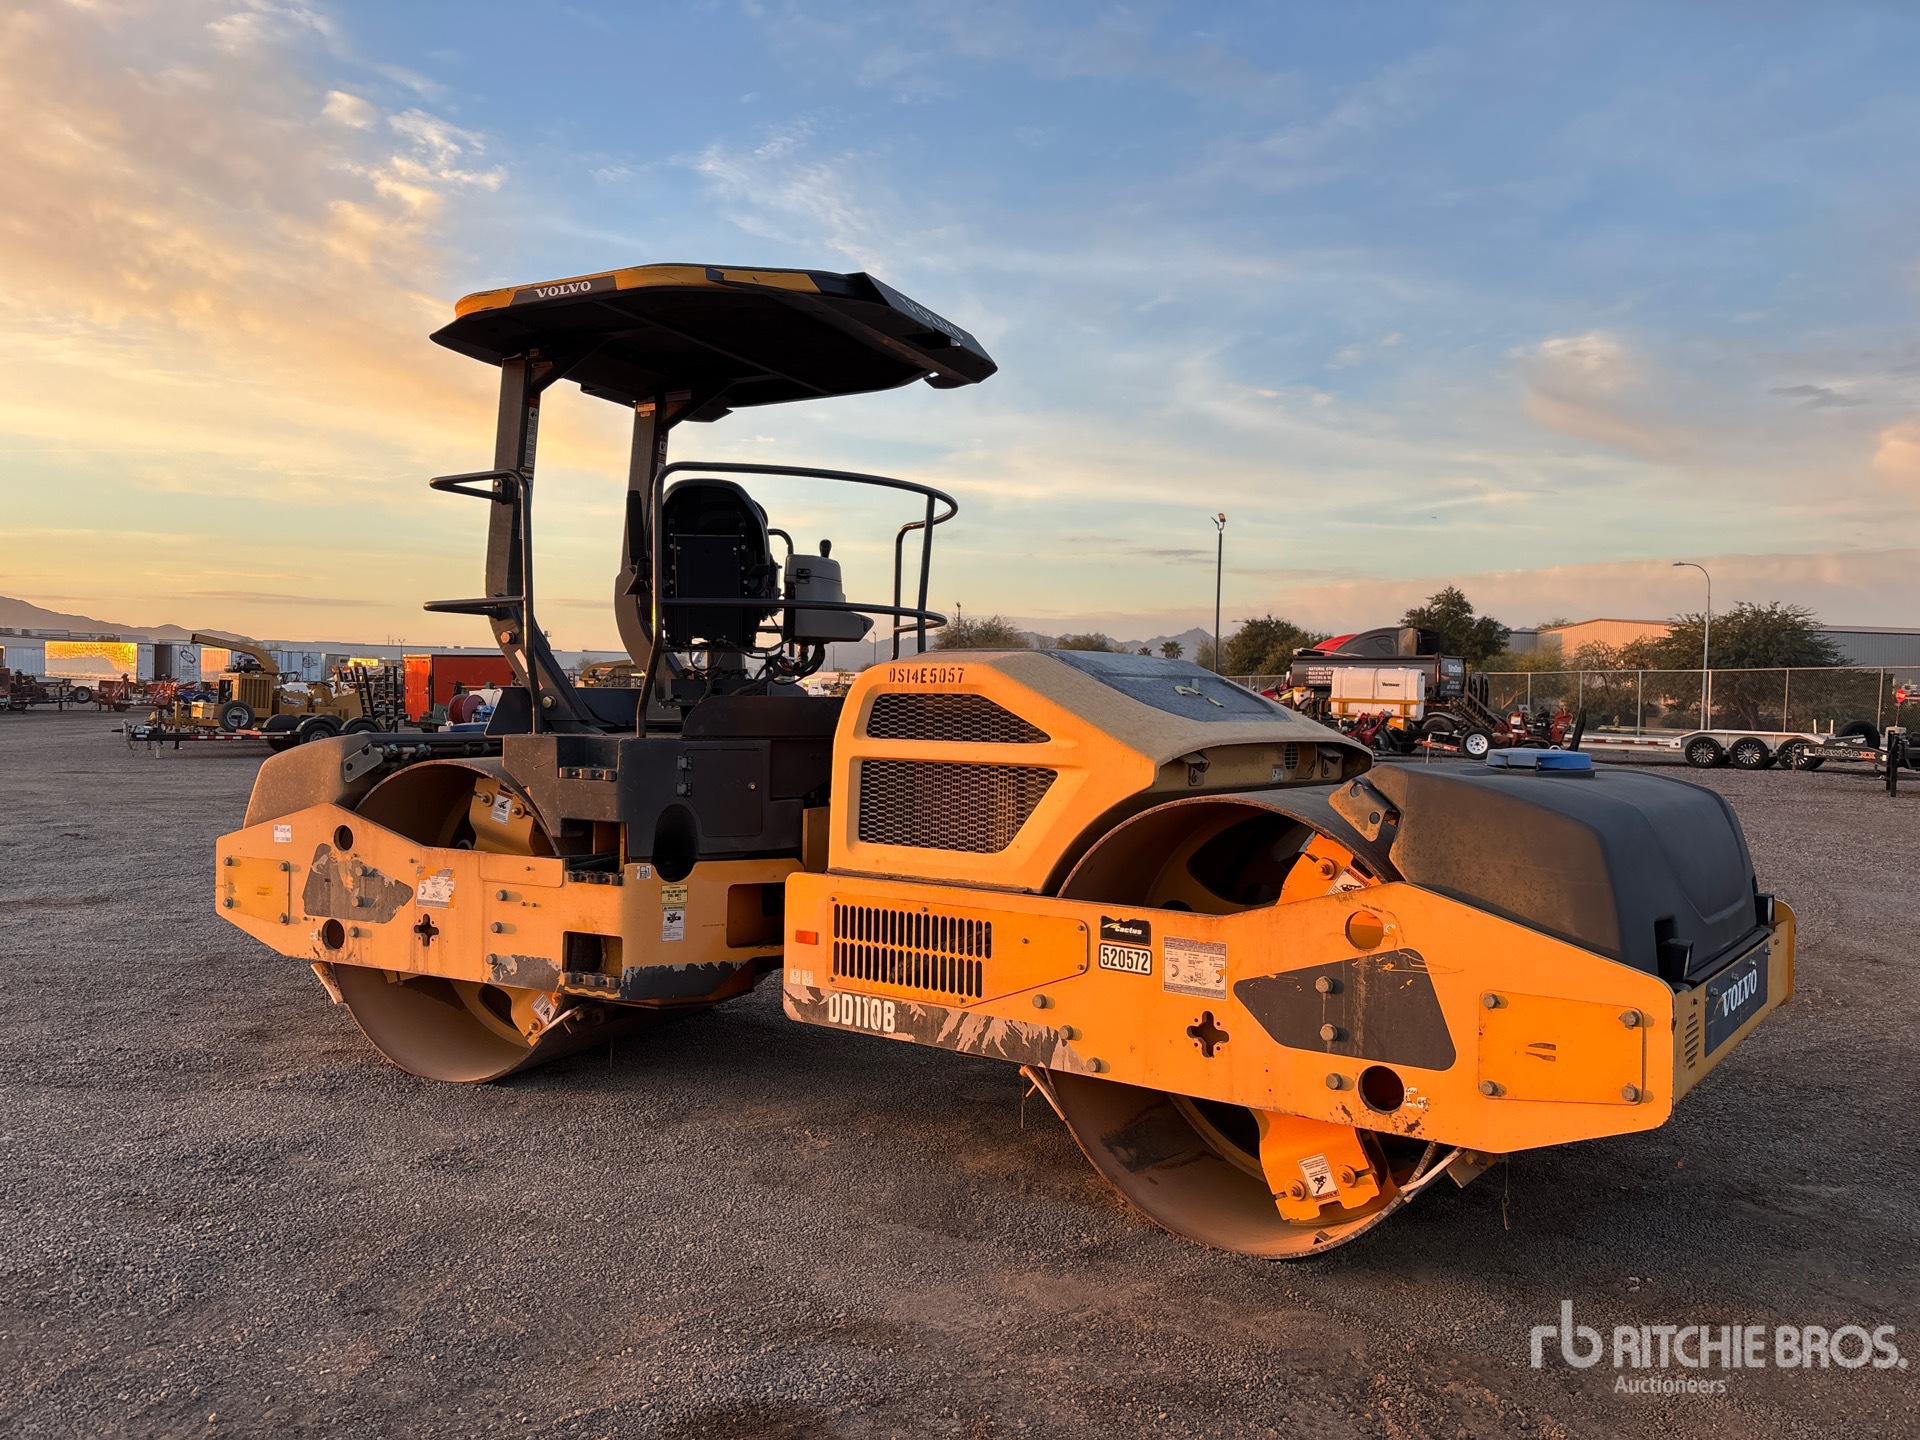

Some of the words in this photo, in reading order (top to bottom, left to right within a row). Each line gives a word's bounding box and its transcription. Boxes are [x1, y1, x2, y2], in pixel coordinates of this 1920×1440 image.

[534, 281, 591, 298] VOLVO
[897, 295, 964, 340] VOLVO
[1102, 947, 1149, 972] 520572
[828, 993, 896, 1033] DD110B
[1721, 969, 1758, 1018] VOLVO
